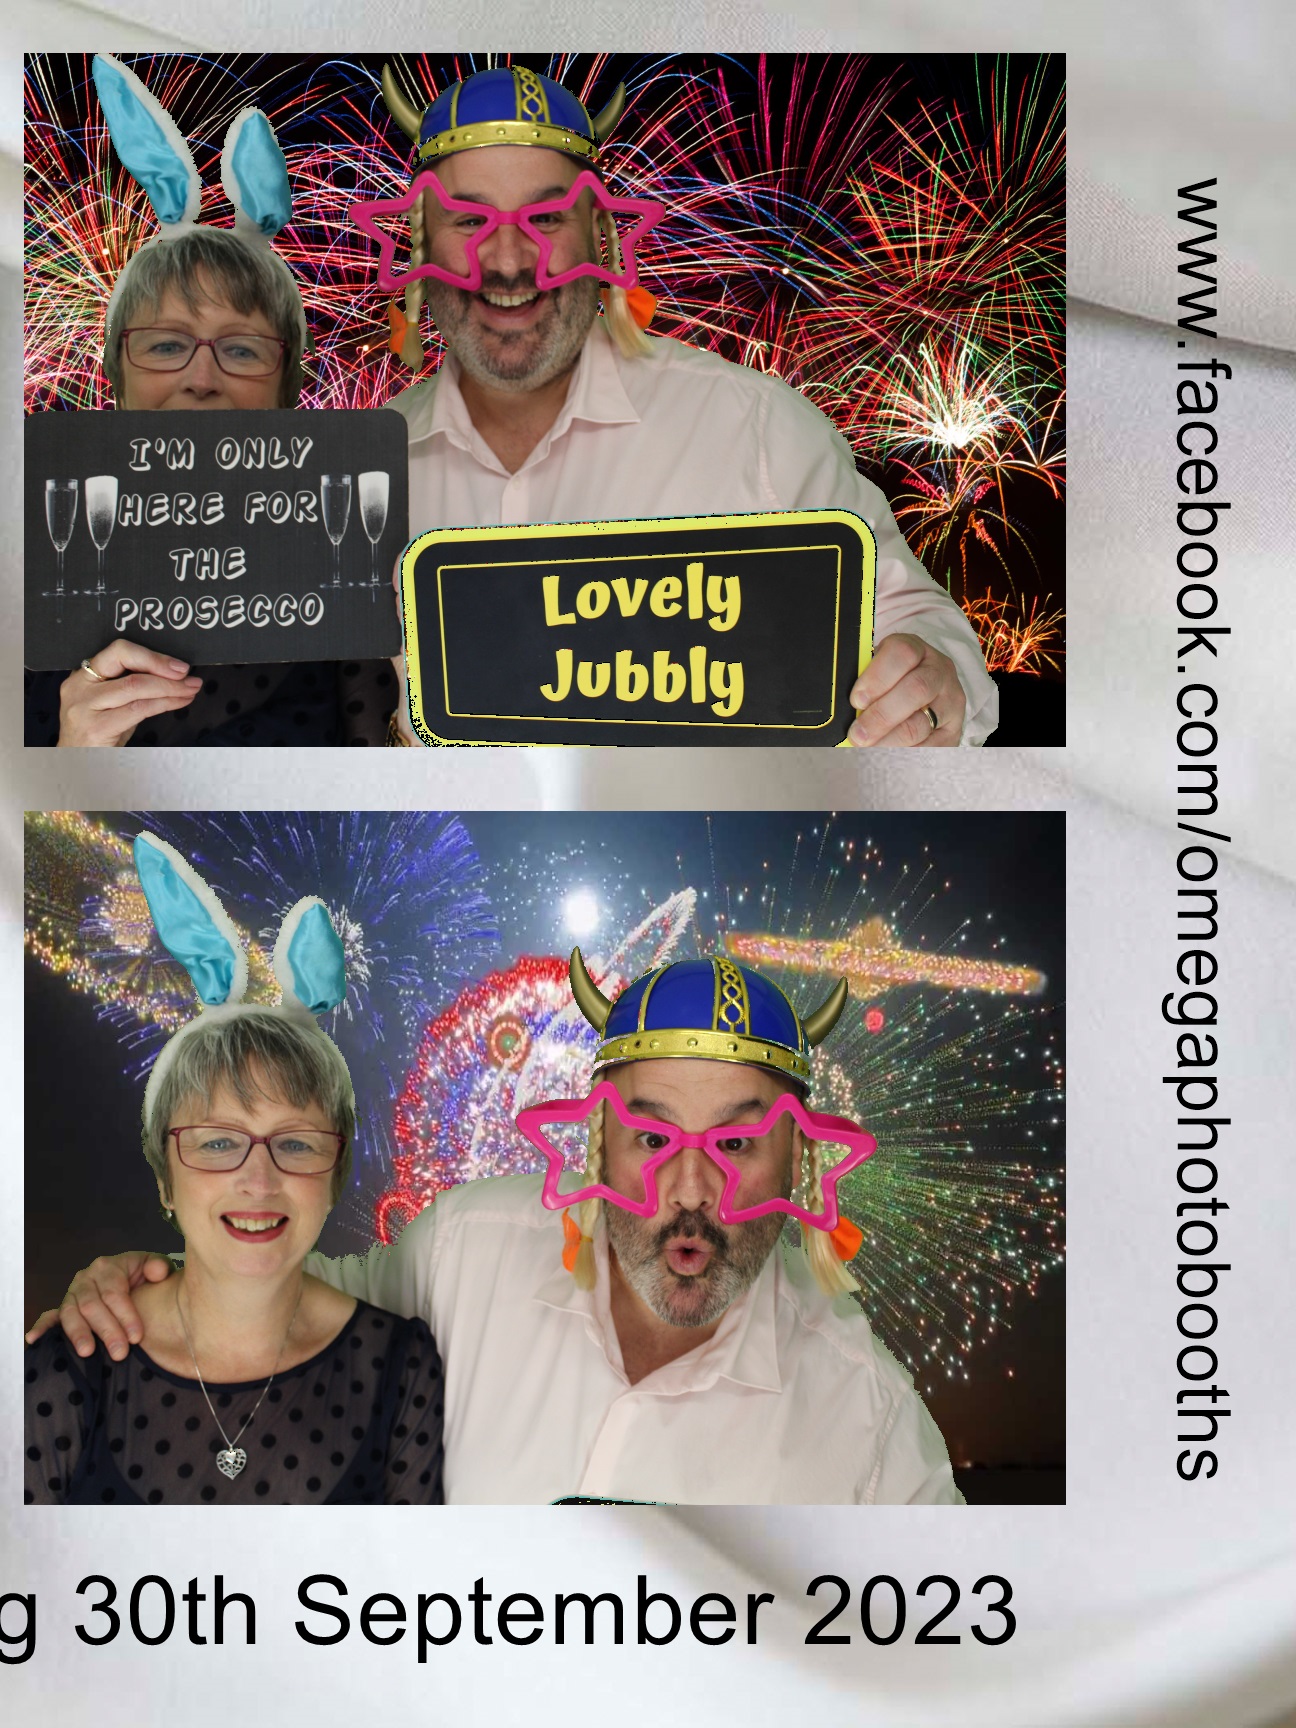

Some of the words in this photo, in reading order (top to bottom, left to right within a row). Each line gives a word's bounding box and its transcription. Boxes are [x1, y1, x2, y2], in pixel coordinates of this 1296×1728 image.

[128, 437, 195, 471] I'M
[215, 436, 313, 470] ONLY
[118, 492, 225, 526] HERE
[244, 490, 318, 524] FOR
[169, 546, 247, 581] THE
[114, 592, 324, 631] PROSECCO
[542, 562, 742, 632] Lovely
[539, 645, 745, 718] Jubbly
